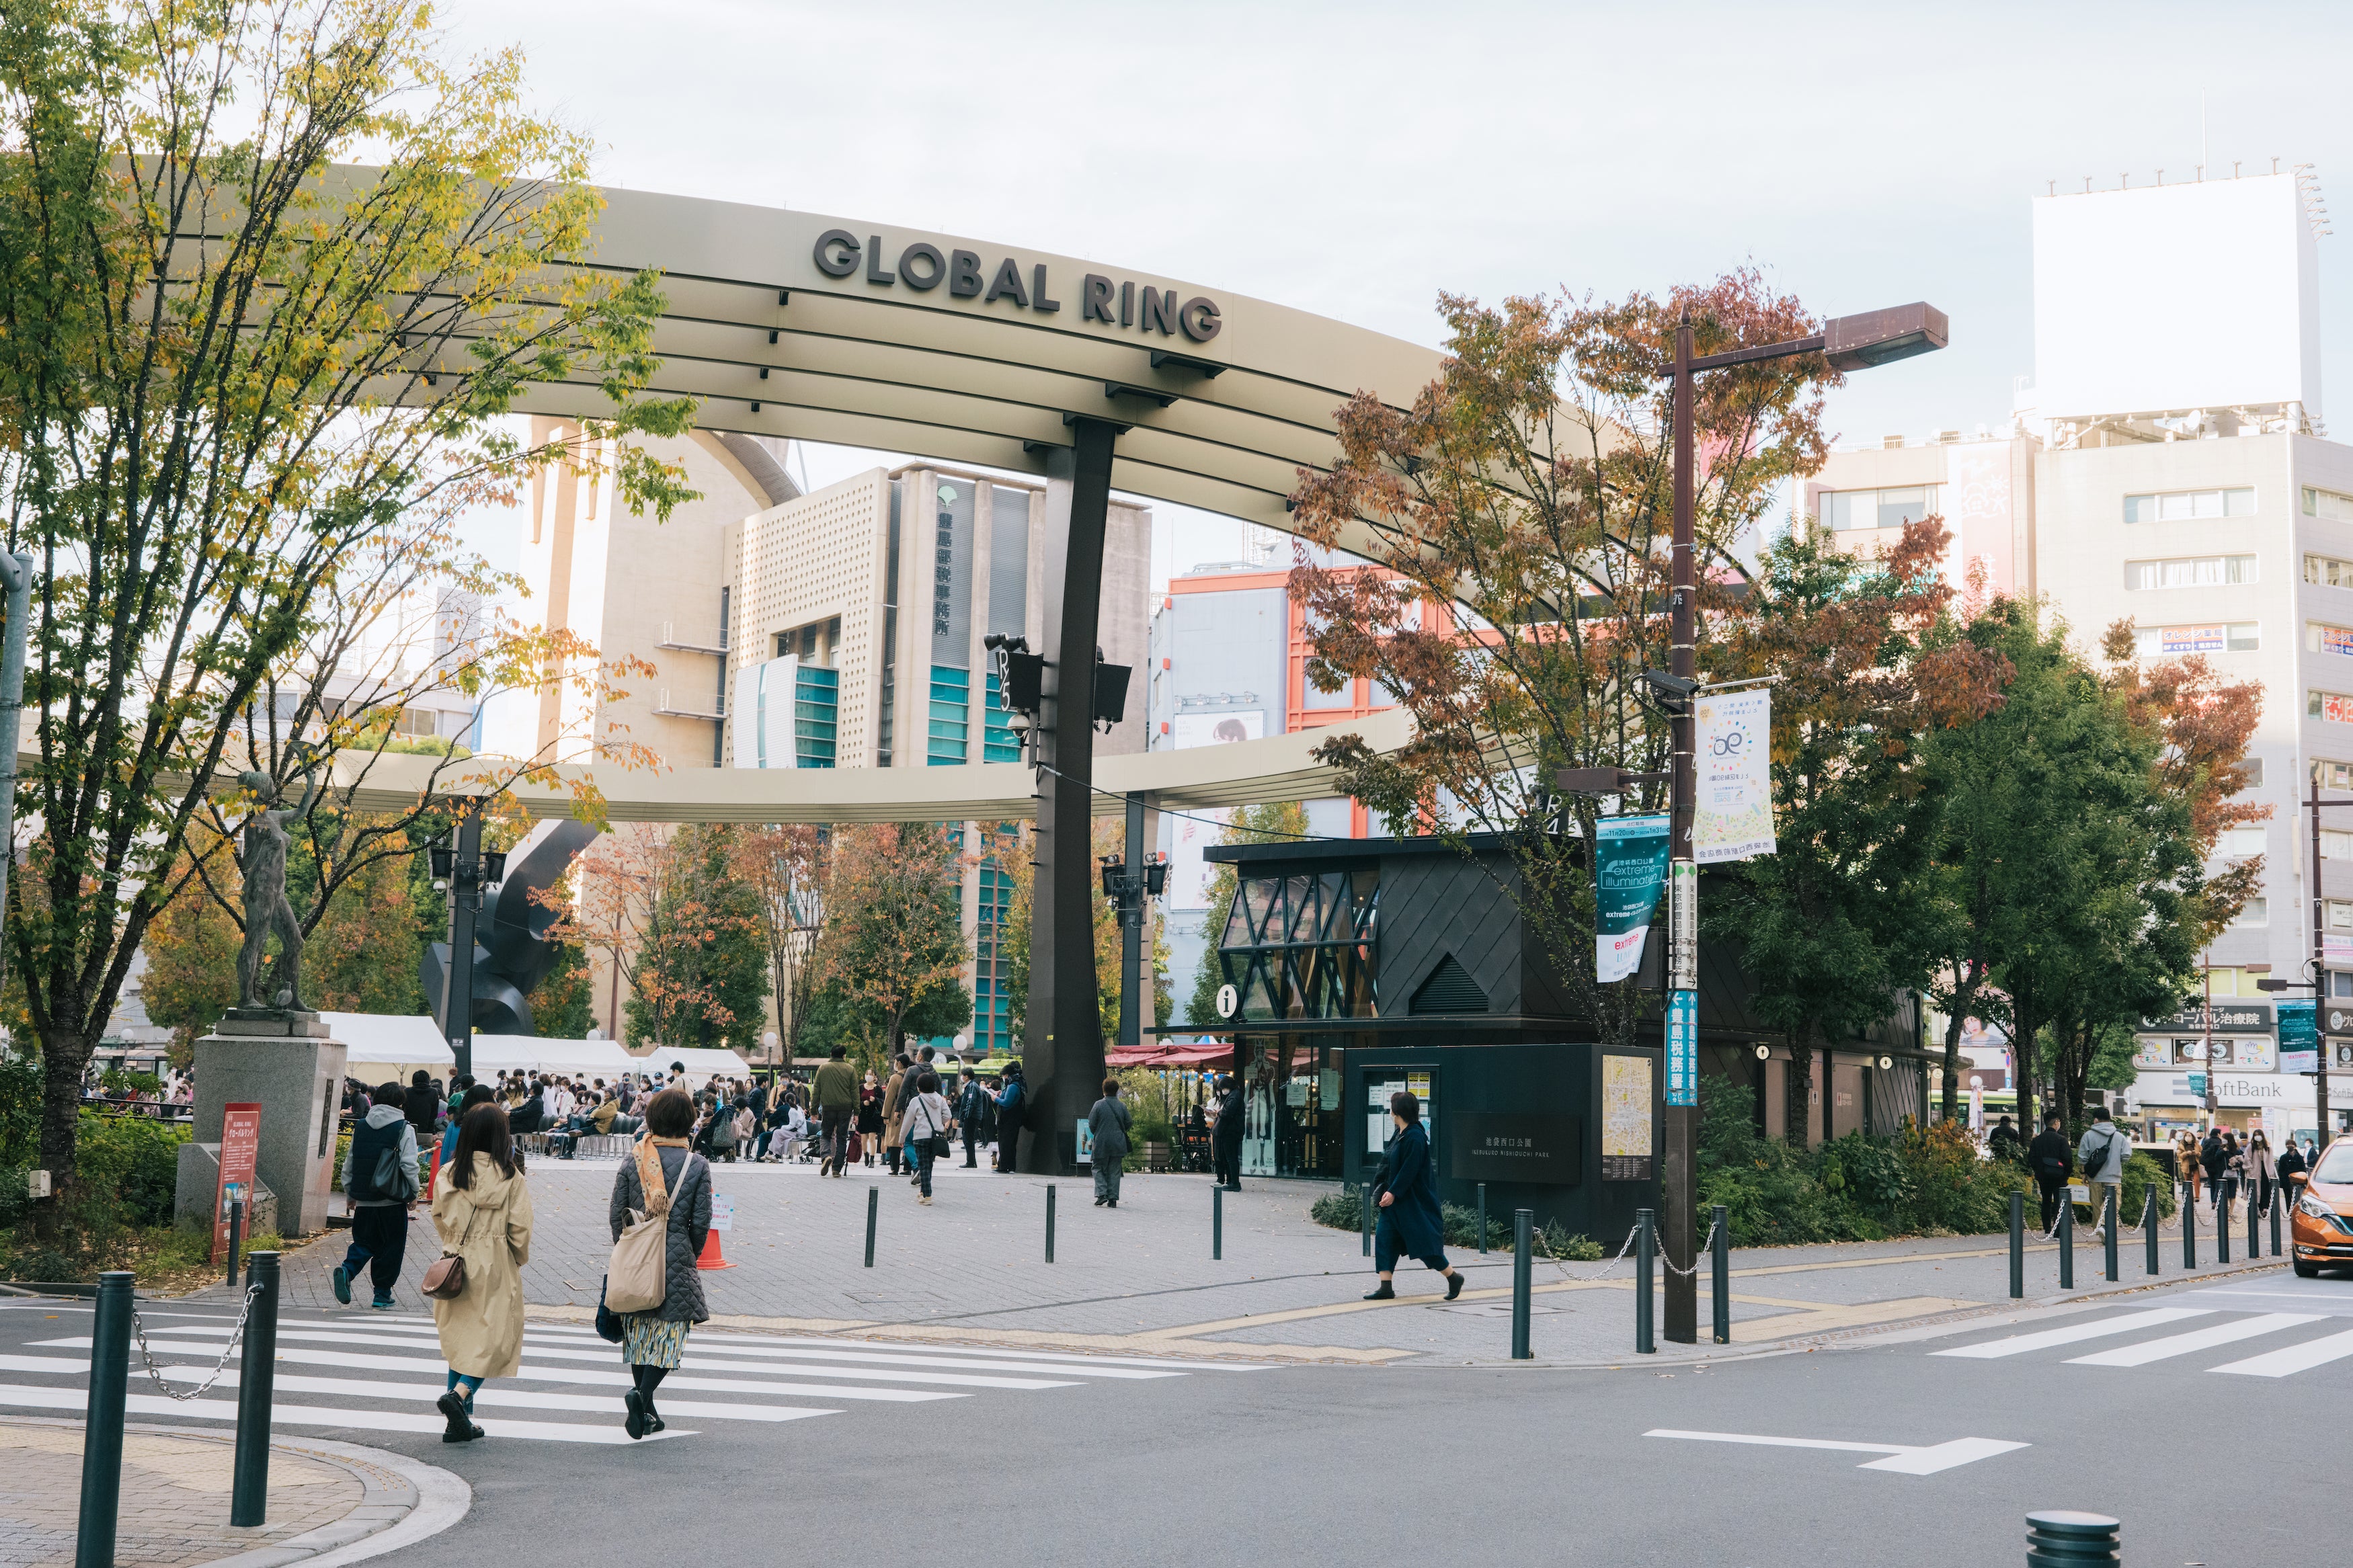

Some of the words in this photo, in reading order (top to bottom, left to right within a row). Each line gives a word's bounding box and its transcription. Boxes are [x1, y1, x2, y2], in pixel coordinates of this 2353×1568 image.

[813, 229, 1060, 312] GLOBAL
[1083, 273, 1222, 342] RING
[935, 513, 953, 636] 豊島都税事務所
[2164, 628, 2222, 640] オレンジ薬局
[1613, 864, 1656, 876] extreme
[1605, 873, 1657, 886] illumination
[1671, 1008, 1683, 1089] 豊島税務署
[2138, 1056, 2167, 1064] てもみん
[2239, 1056, 2269, 1065] てもみん
[2213, 1081, 2282, 1097] oftBank
[1486, 1137, 1531, 1147] 池袋西口公園
